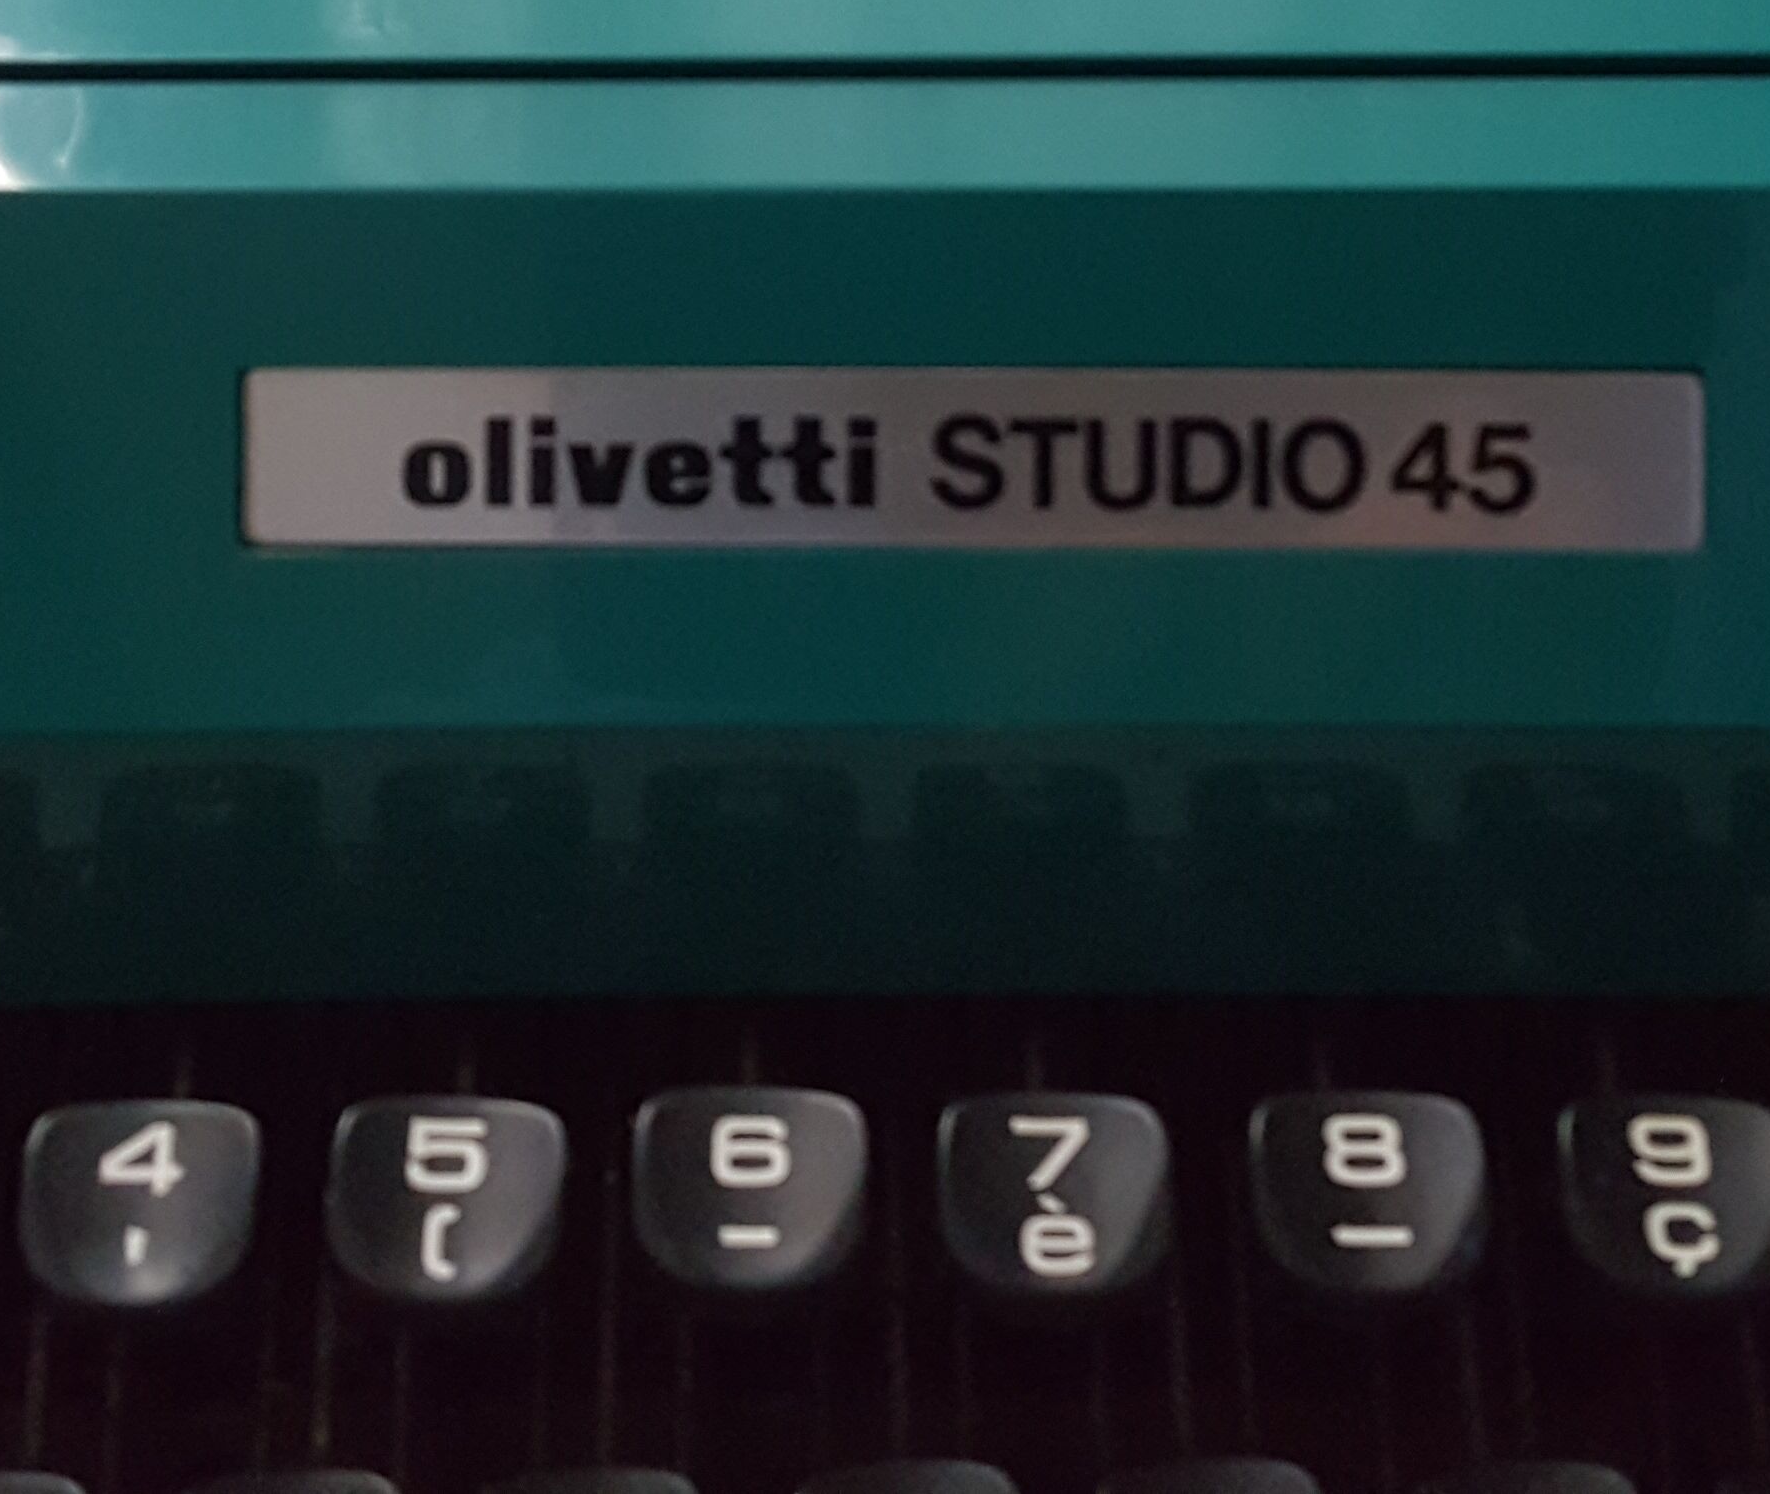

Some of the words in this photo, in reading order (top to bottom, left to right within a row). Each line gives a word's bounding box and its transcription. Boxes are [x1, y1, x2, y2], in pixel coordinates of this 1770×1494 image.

[402, 414, 879, 510] olivetti
[928, 413, 1367, 513] STUDIO
[1390, 423, 1537, 515] 45
[99, 1122, 185, 1198] 4
[406, 1118, 489, 1193] 5
[711, 1116, 791, 1187] 6
[1009, 1117, 1089, 1190] 7
[1324, 1115, 1405, 1186] 8
[1631, 1116, 1710, 1185] 9
[1020, 1194, 1096, 1276] è
[1646, 1202, 1720, 1277] ç
